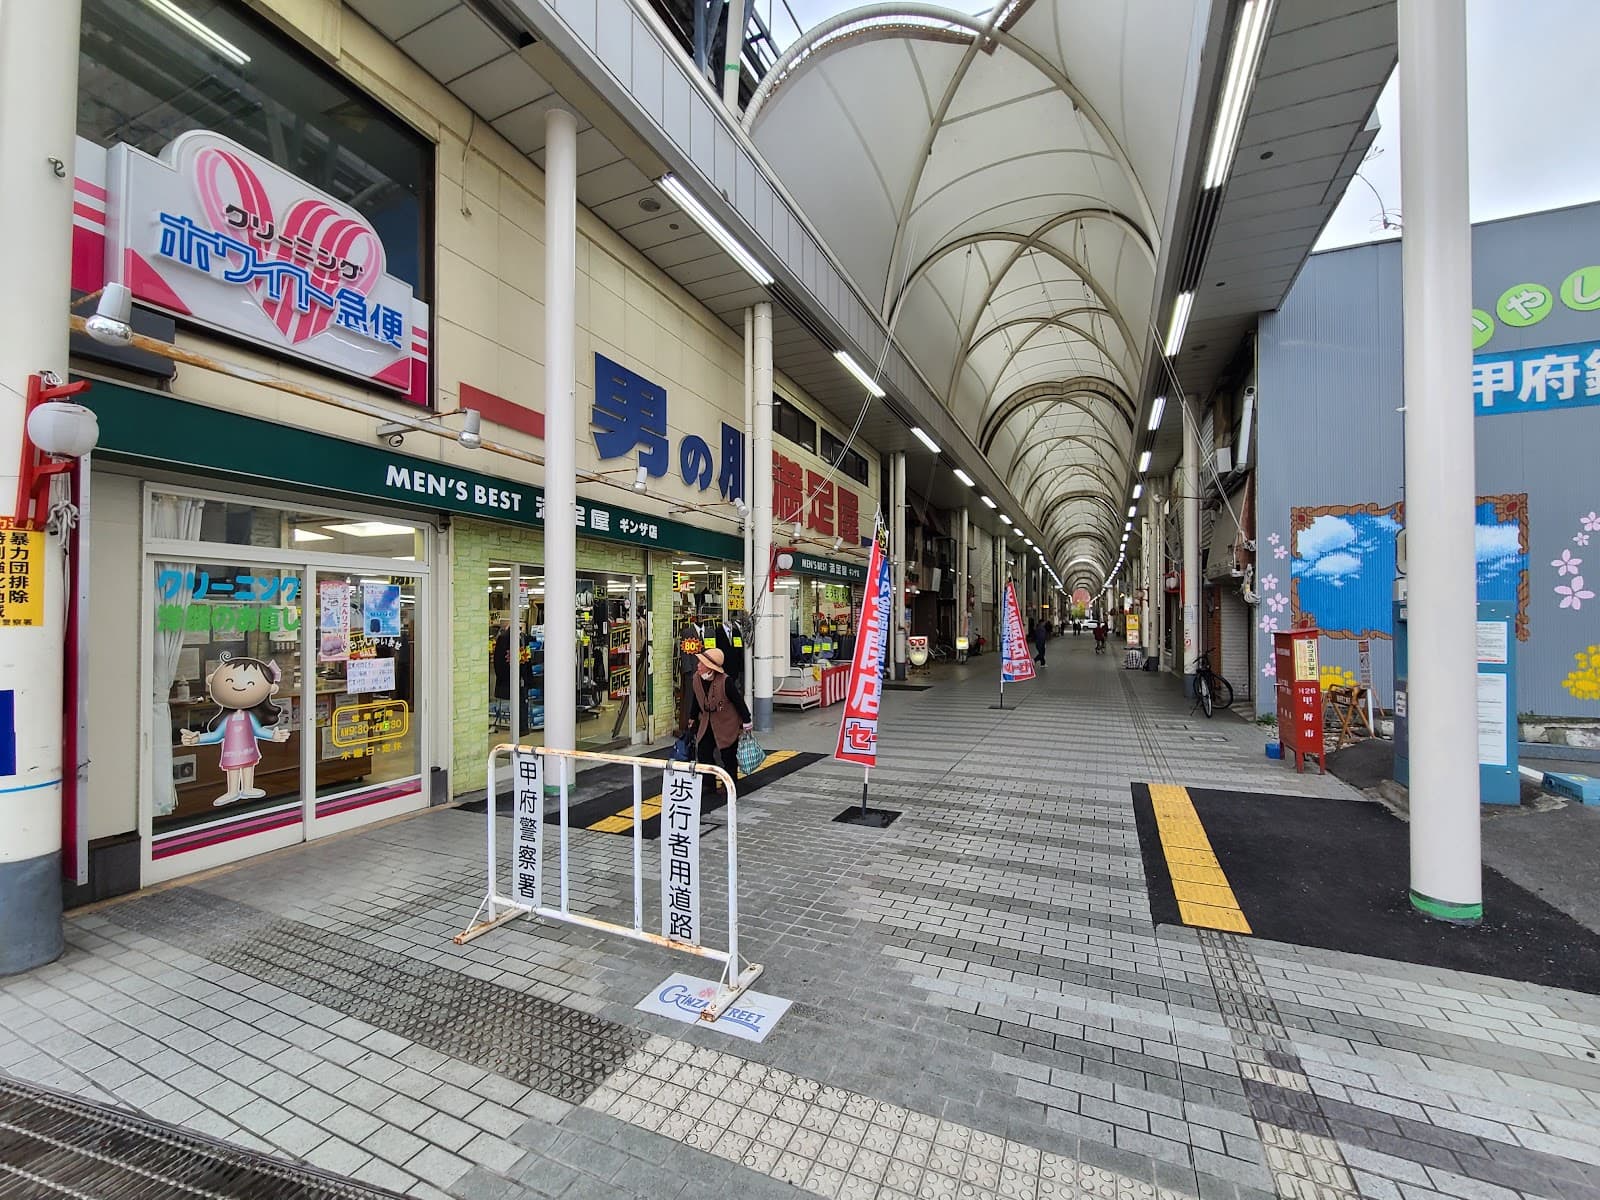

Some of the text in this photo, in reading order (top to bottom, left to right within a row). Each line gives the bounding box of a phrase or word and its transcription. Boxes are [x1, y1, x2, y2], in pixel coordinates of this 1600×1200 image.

[159, 210, 404, 350] ホワイト急便
[224, 203, 364, 281] クリーニング
[1472, 275, 1600, 332] やし
[385, 464, 468, 502] MEN'S
[474, 484, 522, 512] BEST
[619, 518, 658, 540] ギンザ店
[8, 531, 30, 604] 暴力団排除
[517, 760, 538, 899] 甲府警察署
[668, 777, 694, 941] 歩行者用道路
[727, 1007, 766, 1025] REET
